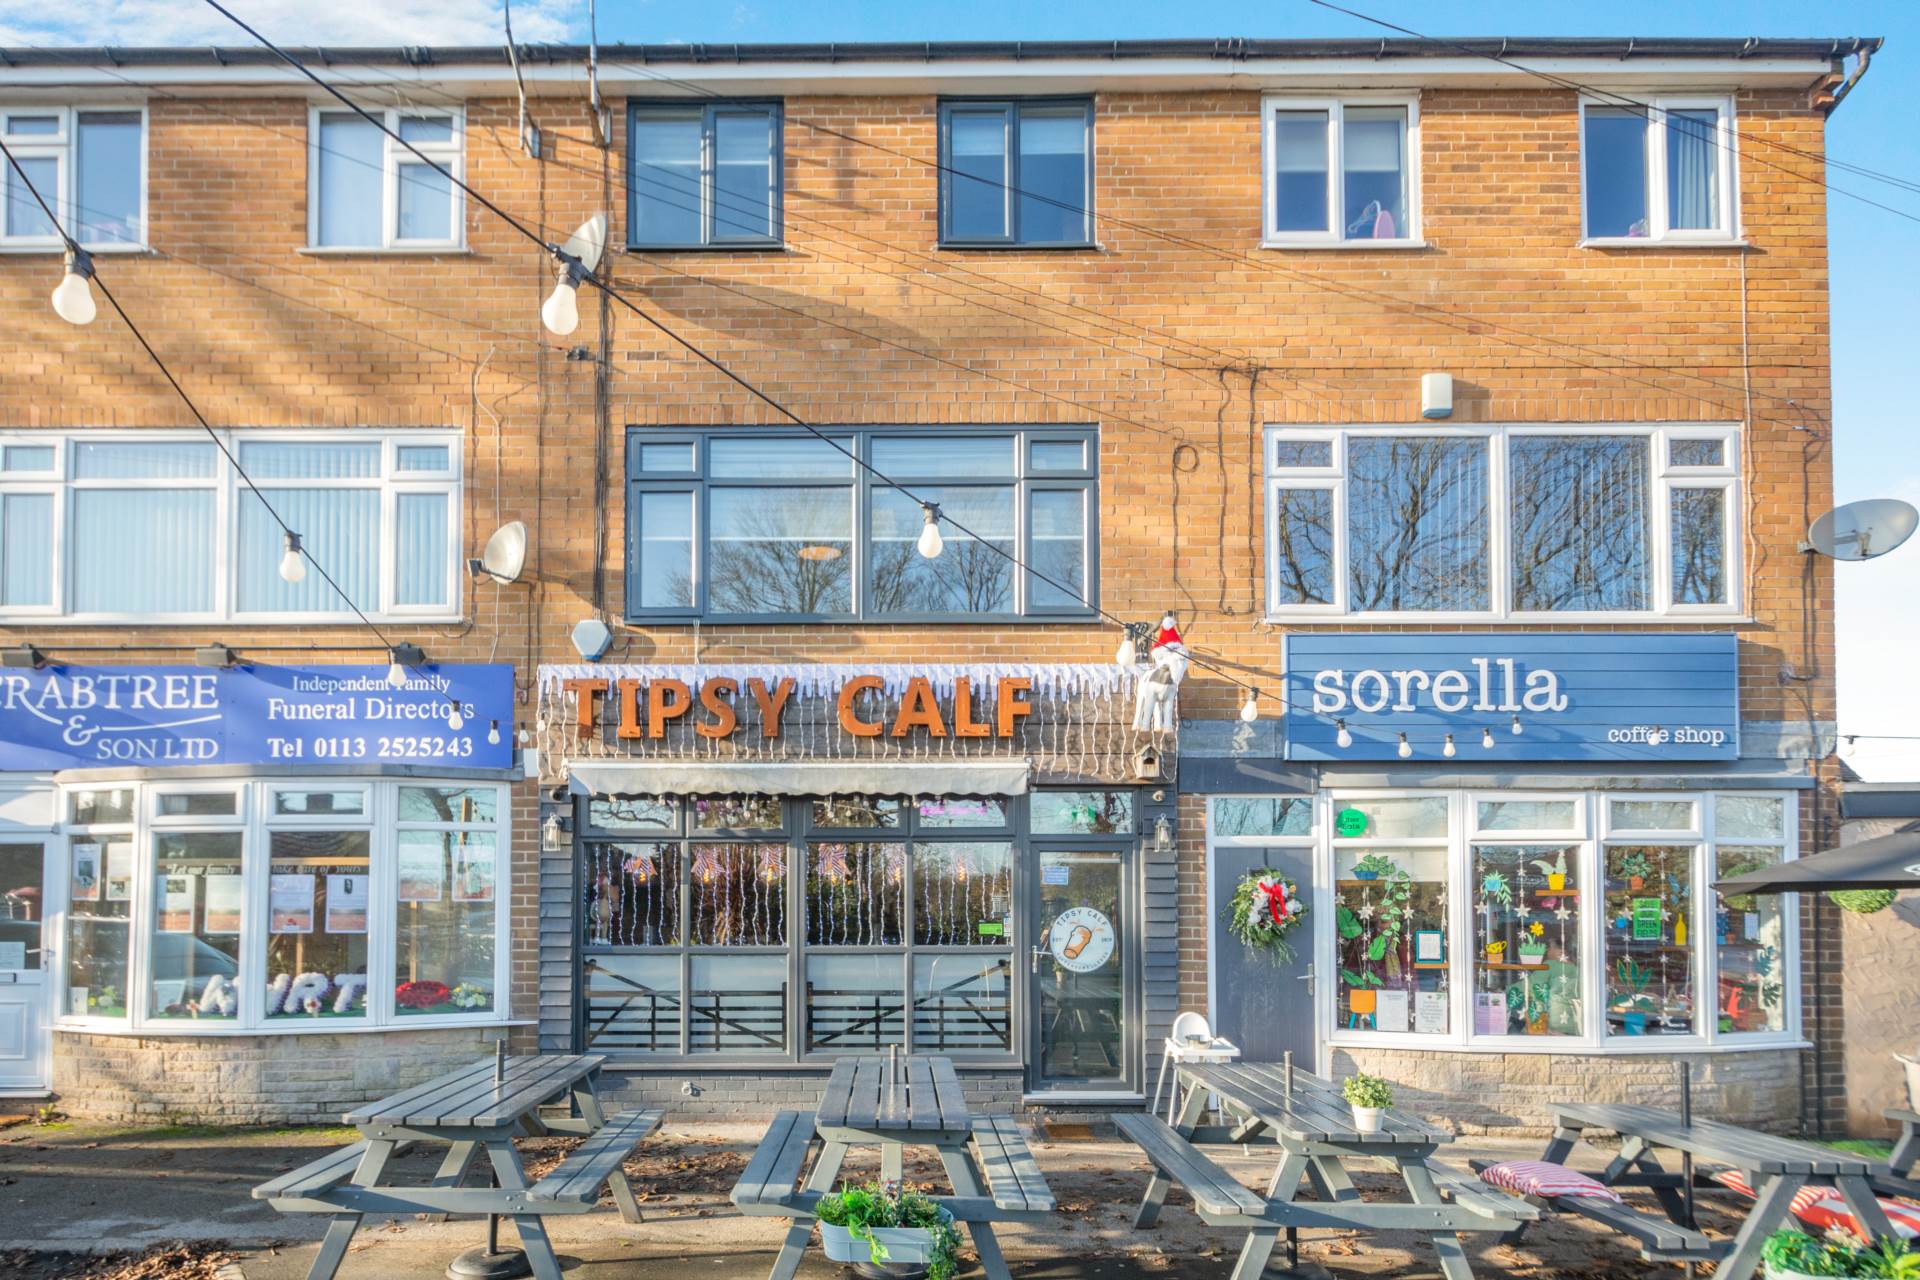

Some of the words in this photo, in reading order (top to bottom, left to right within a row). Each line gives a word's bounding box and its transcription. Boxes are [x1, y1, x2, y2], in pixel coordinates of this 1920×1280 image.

[0, 675, 219, 712] RABTREE
[292, 675, 390, 695] Independent
[1312, 657, 1569, 713] sorella
[267, 697, 356, 720] Funeral
[562, 677, 796, 738] TIPSY
[837, 674, 1032, 738] CALF
[63, 715, 99, 746] &
[96, 738, 157, 760] SON
[163, 738, 219, 760] LTD
[267, 737, 303, 758] Tel
[314, 737, 366, 758] 0113
[377, 736, 473, 758] 2525243
[1674, 725, 1725, 747] shop
[1056, 908, 1082, 926] TIPSY
[1087, 910, 1108, 926] CALF
